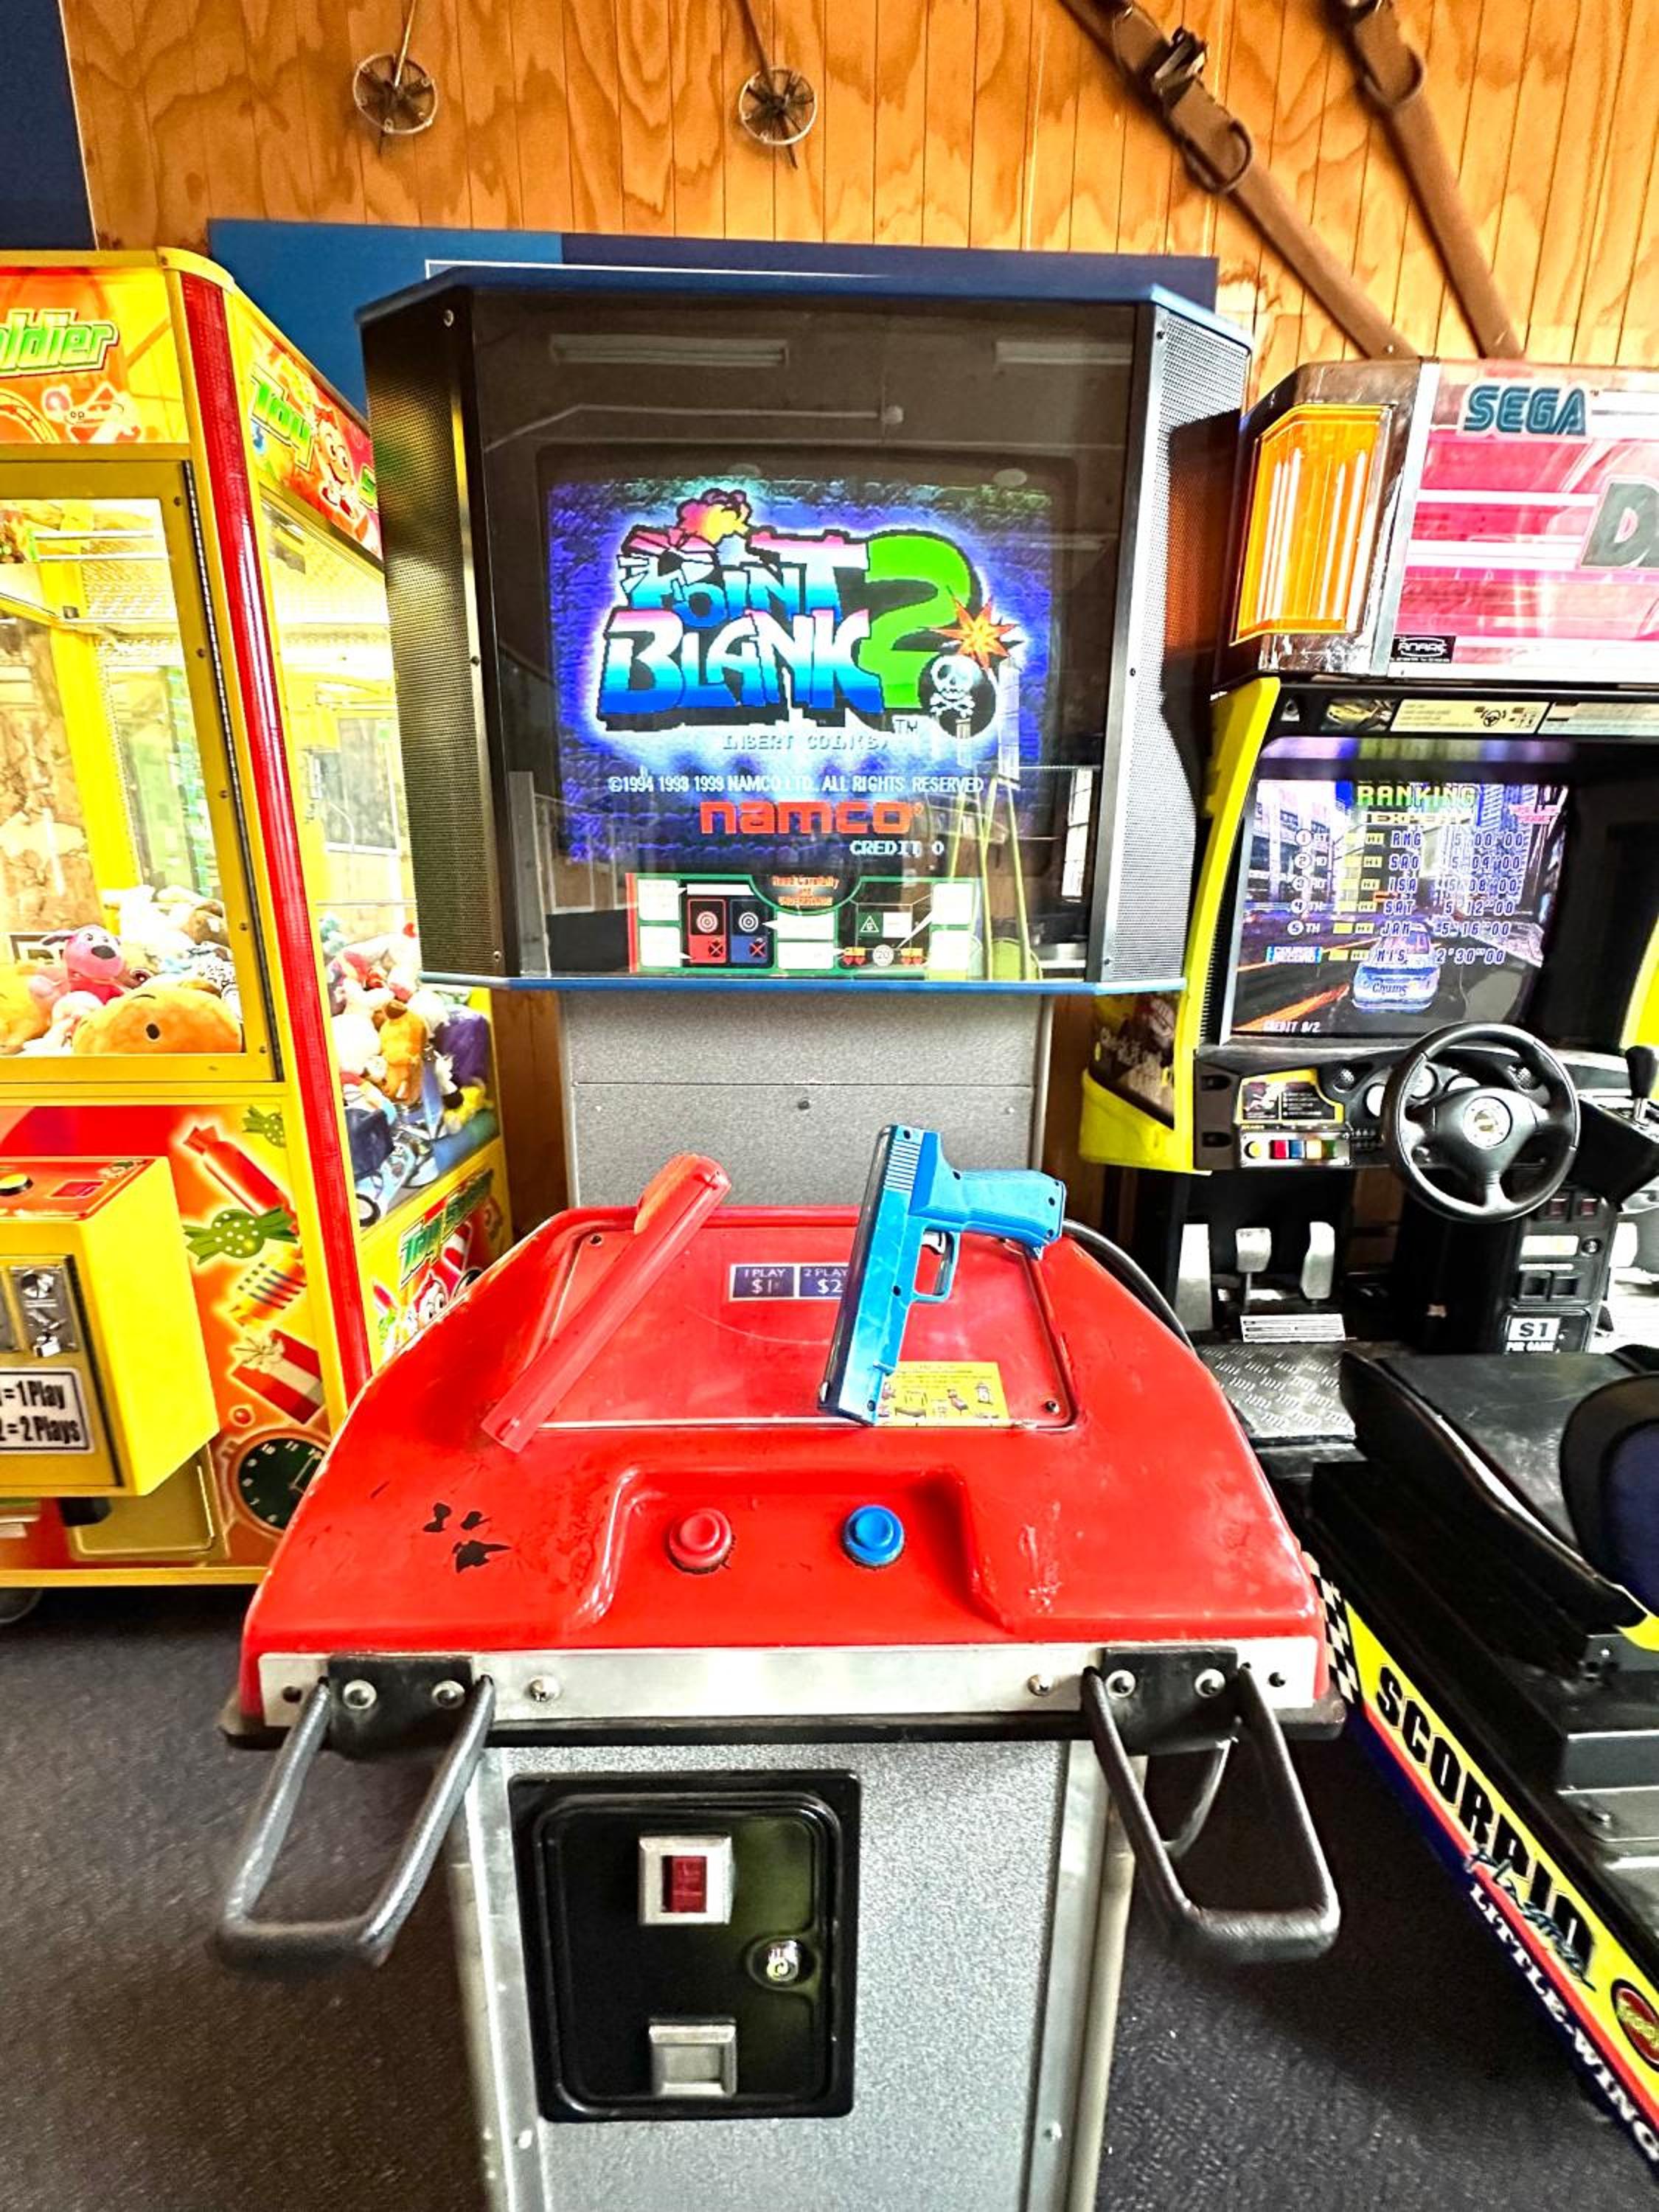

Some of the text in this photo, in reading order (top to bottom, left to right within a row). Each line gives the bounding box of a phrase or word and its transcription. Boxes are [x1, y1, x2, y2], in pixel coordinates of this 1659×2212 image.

[1464, 385, 1587, 436] SEGA
[599, 532, 972, 715] BLANK 2
[728, 775, 782, 792] NAMCO
[822, 776, 848, 791] ALL
[852, 776, 904, 791] RIGHTS
[912, 776, 984, 792] RESERVED
[1357, 785, 1475, 807] RANKING
[849, 840, 922, 857] CREDIT
[751, 1268, 787, 1278] PLAY
[816, 1279, 845, 1295] $2
[27, 1380, 65, 1410] Play
[32, 1416, 81, 1444] Plays
